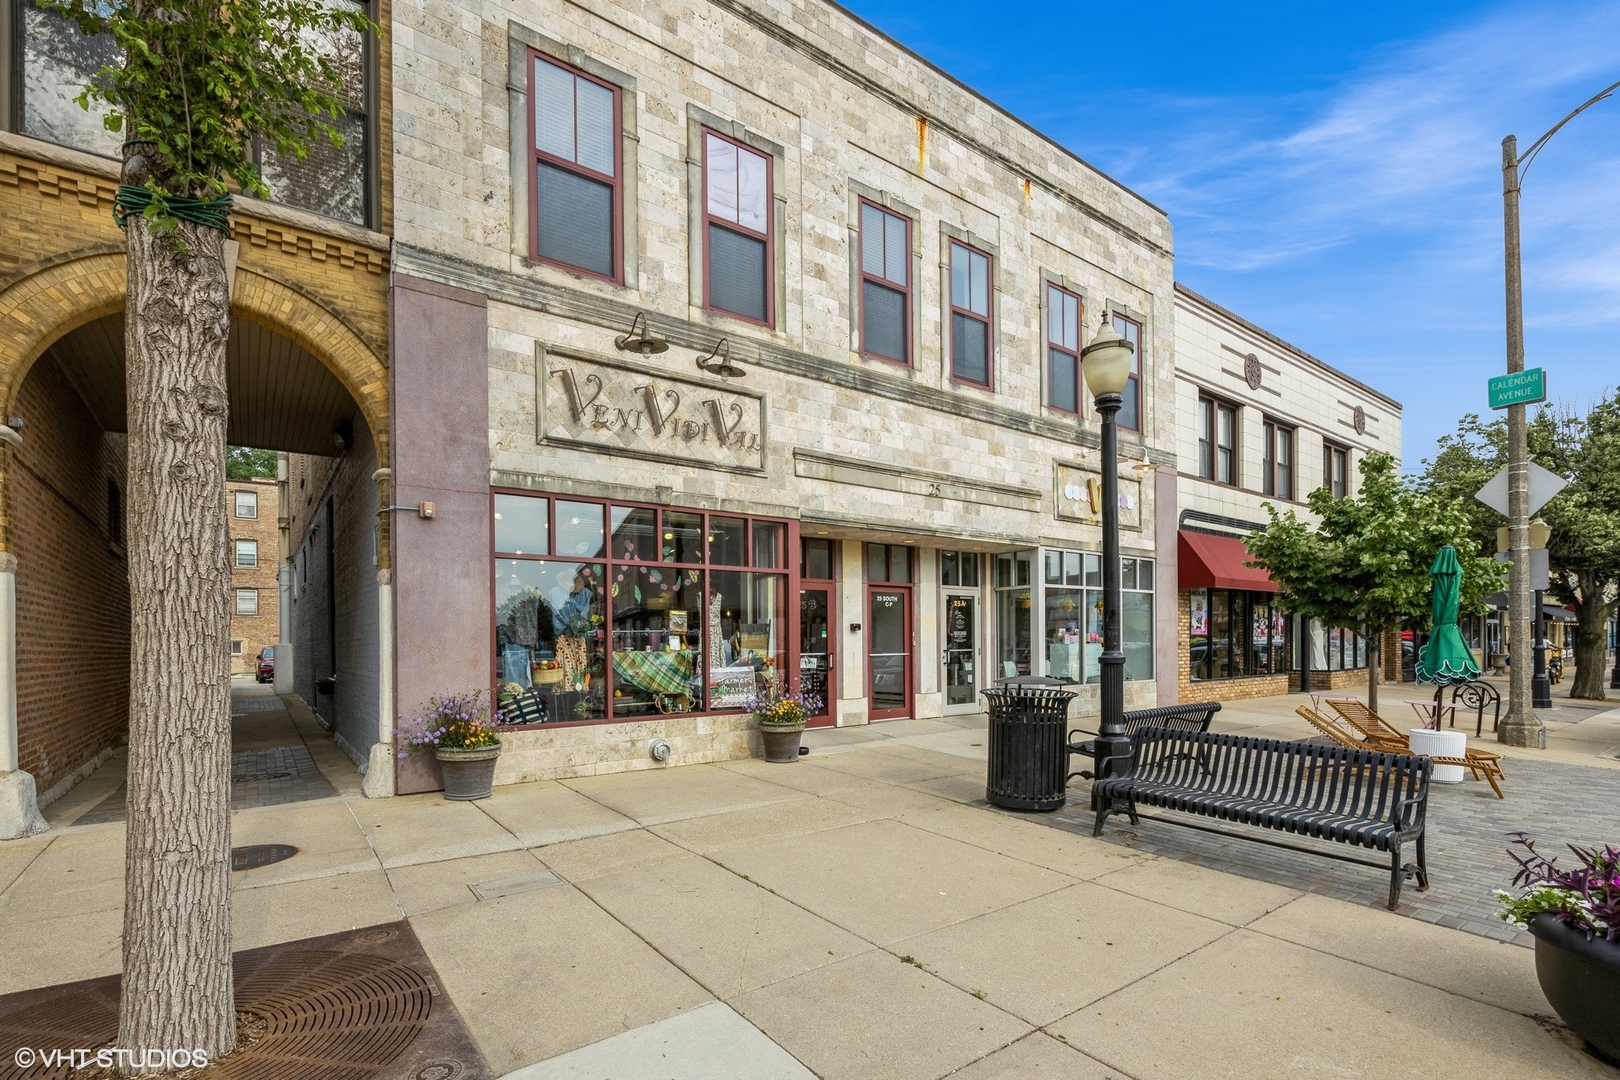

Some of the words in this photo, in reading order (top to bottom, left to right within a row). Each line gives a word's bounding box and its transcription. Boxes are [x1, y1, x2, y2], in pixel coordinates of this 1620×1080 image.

[1491, 373, 1539, 391] CALENDAR
[1497, 386, 1533, 402] AVENUE
[928, 483, 941, 497] 25
